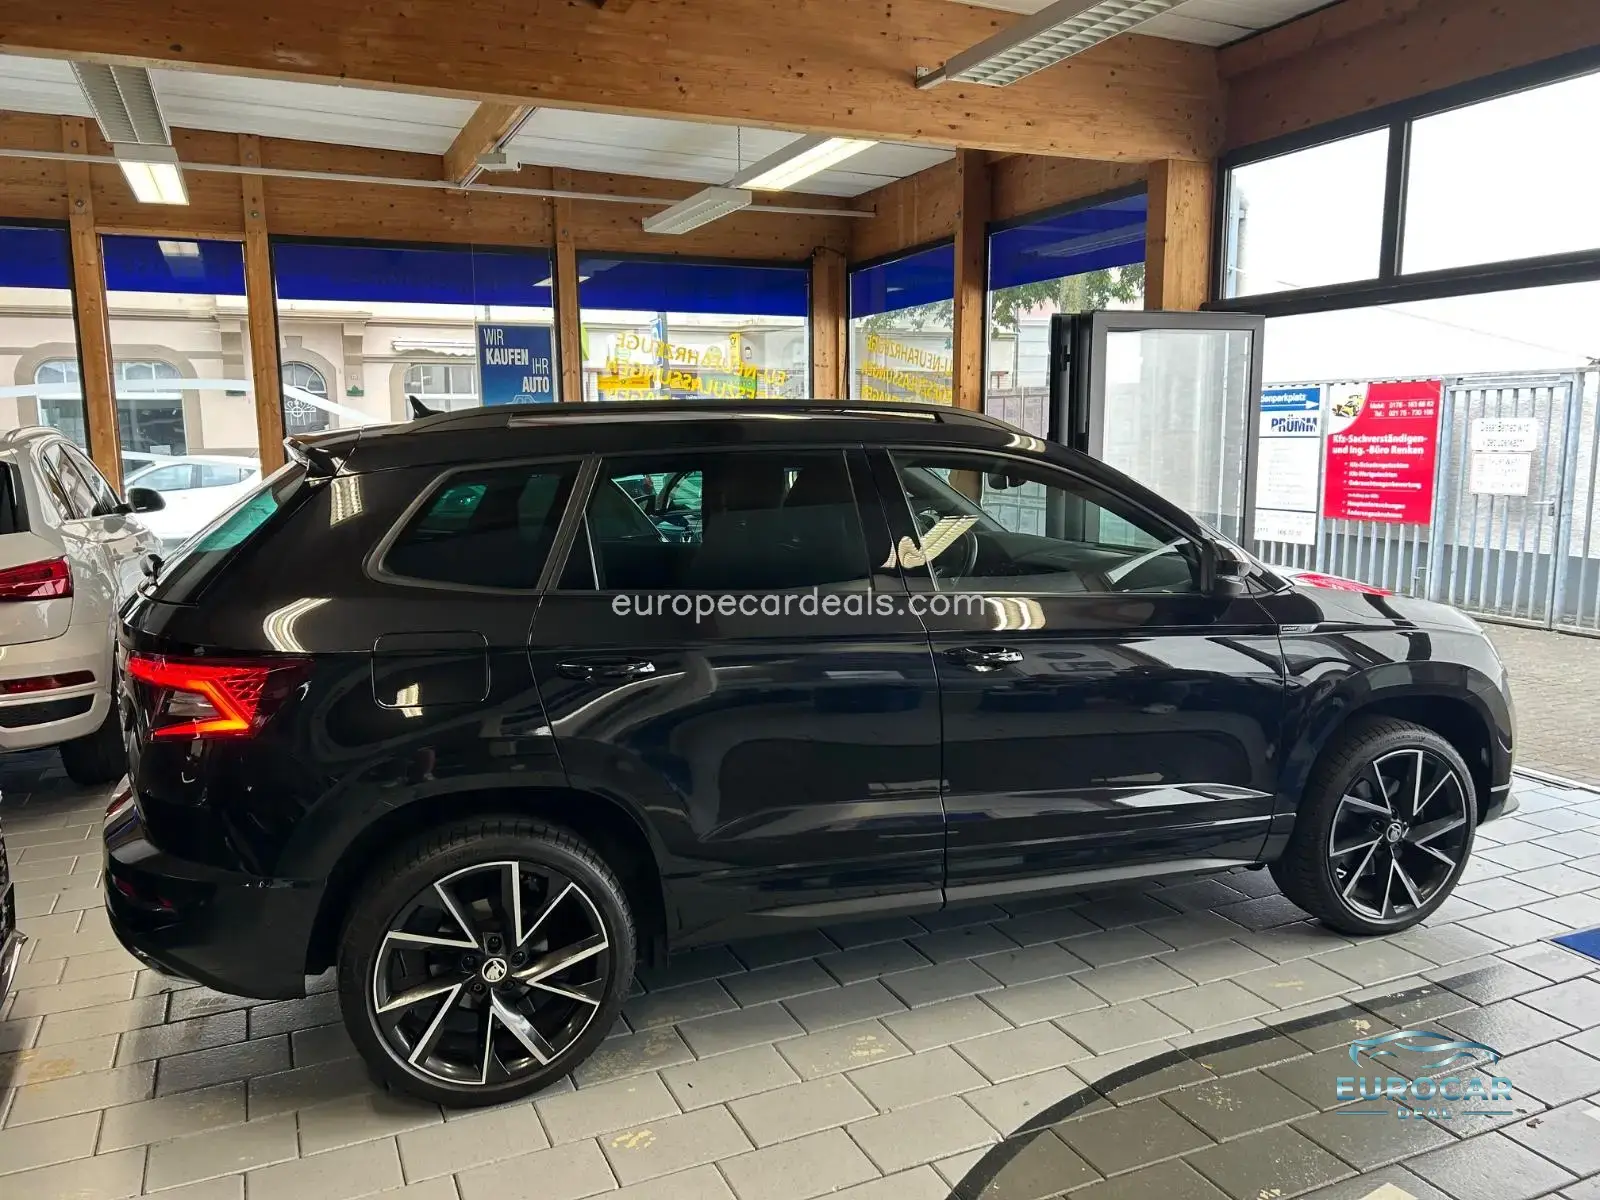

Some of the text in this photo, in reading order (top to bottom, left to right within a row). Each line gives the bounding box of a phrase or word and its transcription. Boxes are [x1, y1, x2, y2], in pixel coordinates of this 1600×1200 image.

[483, 328, 504, 346] WIR
[485, 348, 529, 366] KAUFEN
[532, 357, 549, 375] IHR
[521, 376, 550, 393] AUTO
[1271, 413, 1318, 433] PRÜMM
[1332, 445, 1349, 454] und
